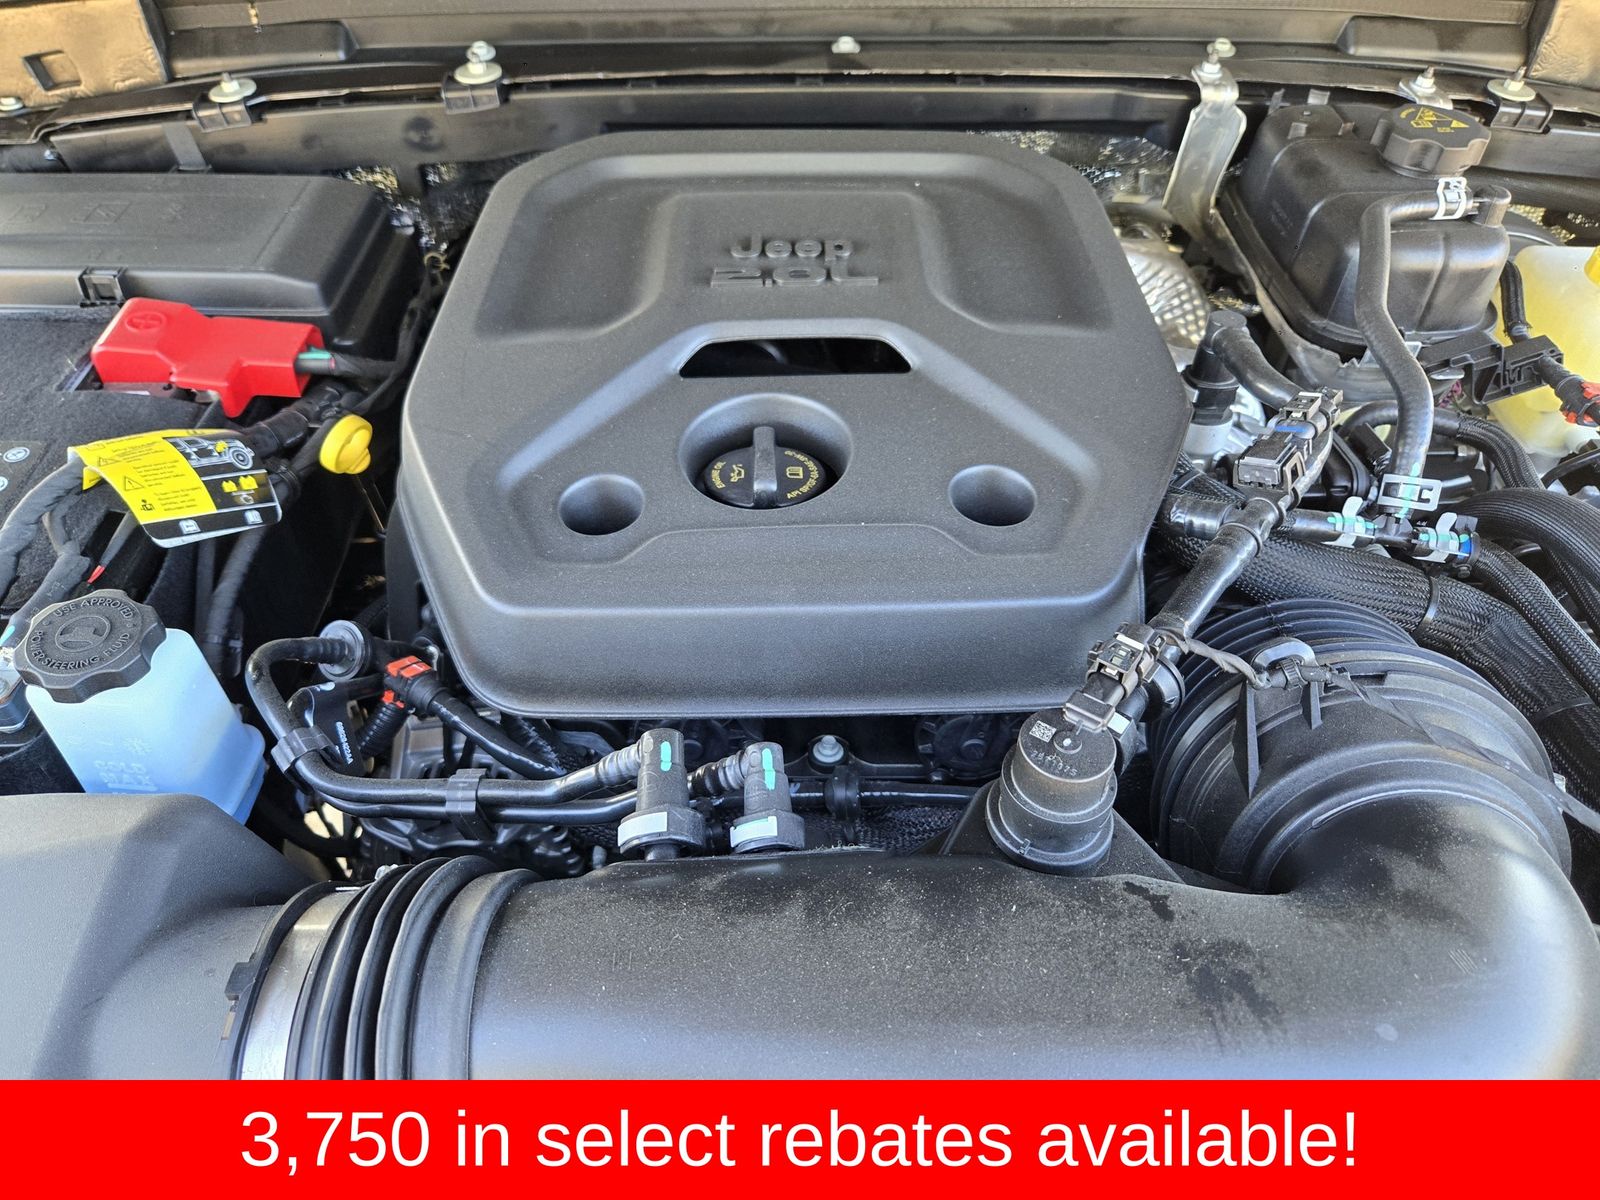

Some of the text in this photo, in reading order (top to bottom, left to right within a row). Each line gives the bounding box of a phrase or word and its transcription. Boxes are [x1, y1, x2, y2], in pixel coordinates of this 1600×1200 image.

[730, 233, 852, 265] Jeep
[710, 267, 879, 288] 2.0L
[711, 461, 726, 489] ENGINE OIL
[786, 490, 802, 499] API
[53, 597, 136, 620] USE APPROVED
[30, 630, 131, 671] POWER STEERING FLUID
